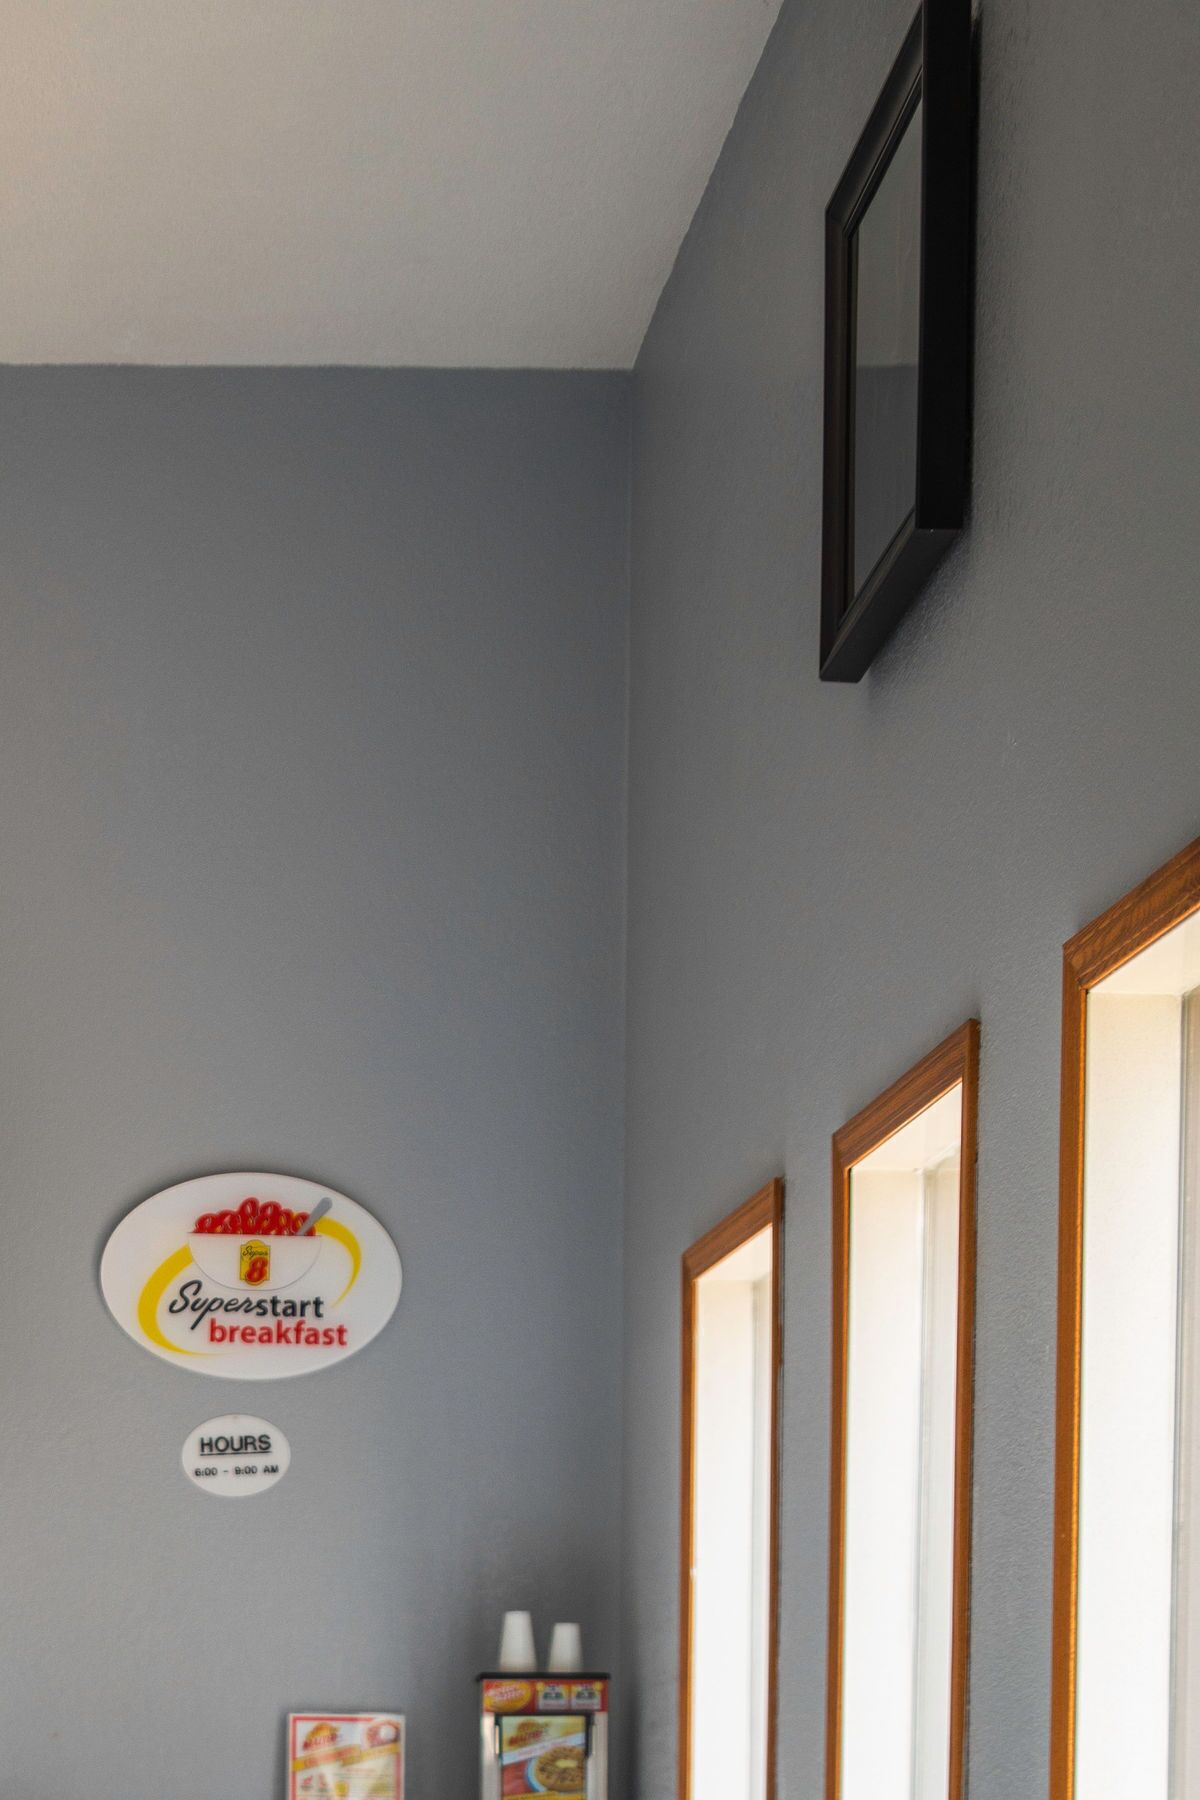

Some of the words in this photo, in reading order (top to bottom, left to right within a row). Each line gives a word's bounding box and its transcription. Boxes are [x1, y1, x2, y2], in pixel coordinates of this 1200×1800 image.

[244, 1256, 269, 1283] 8
[208, 1316, 349, 1347] breakfast
[199, 1434, 272, 1454] HOURS
[194, 1466, 219, 1477] 6:00
[262, 1464, 280, 1474] AM
